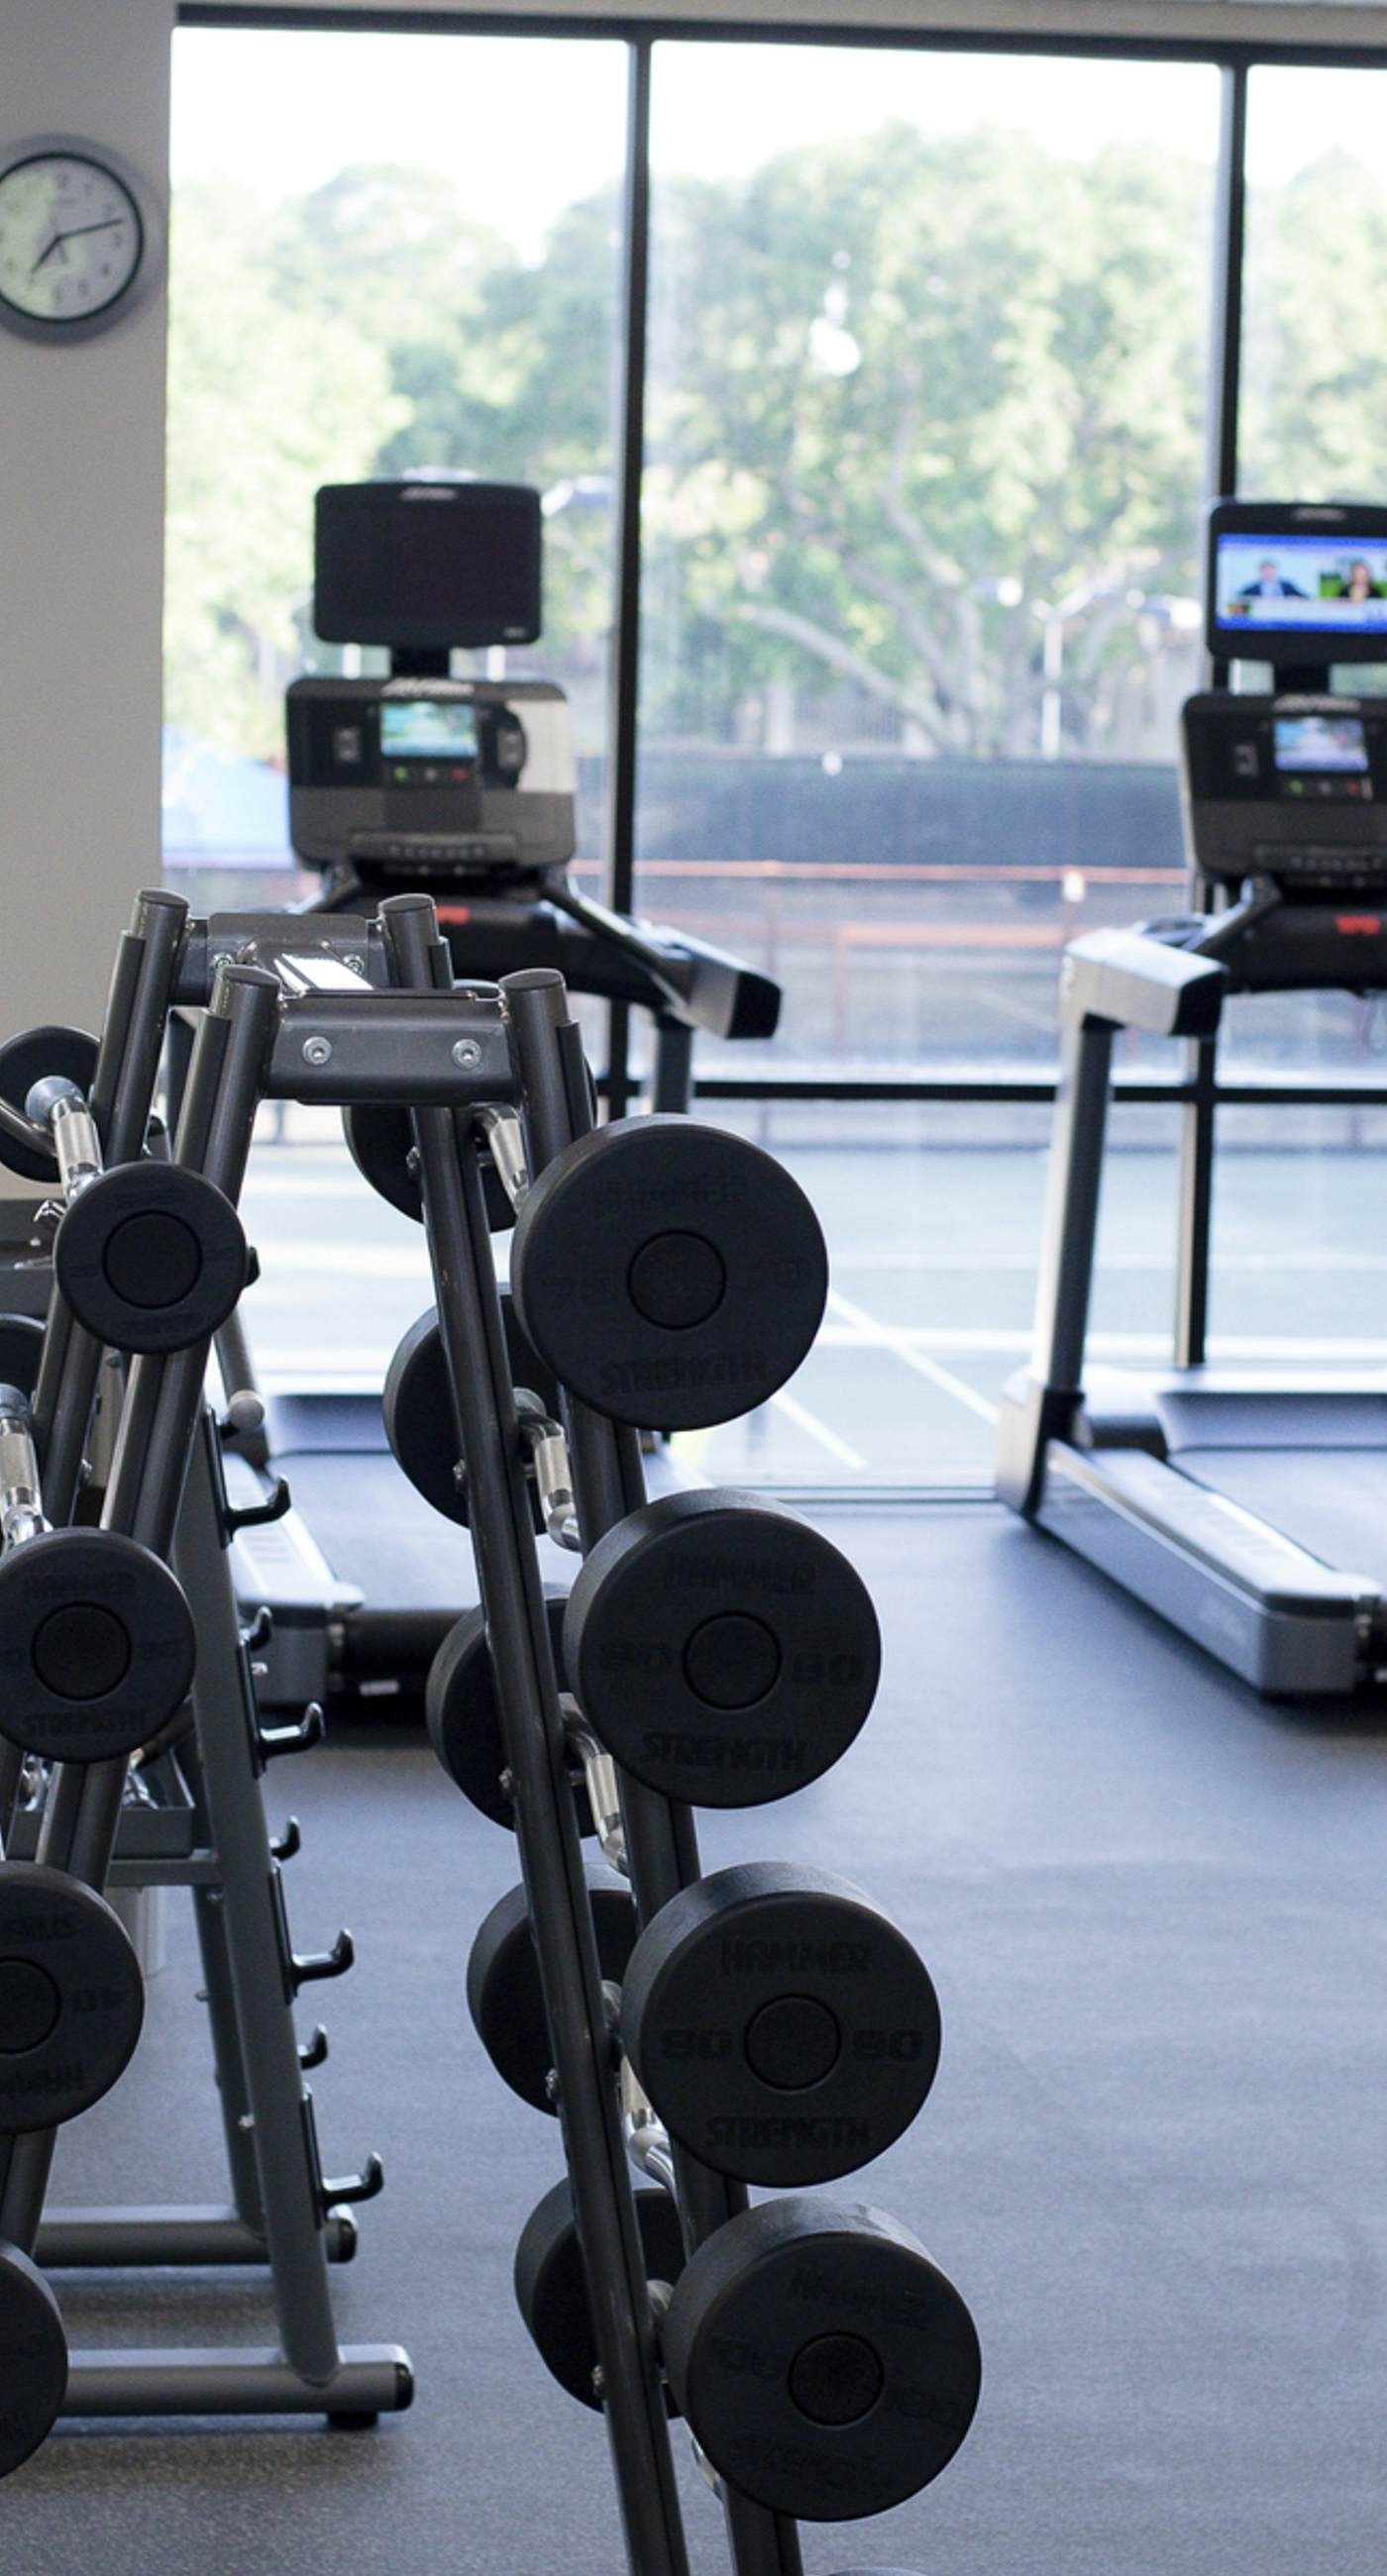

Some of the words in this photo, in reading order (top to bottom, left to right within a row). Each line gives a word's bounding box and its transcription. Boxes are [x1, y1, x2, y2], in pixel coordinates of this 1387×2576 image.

[642, 1732, 810, 1773] STRENGTH
[720, 1938, 872, 1977] HAMMER
[659, 2028, 733, 2061] 80
[851, 2029, 924, 2063] 80
[703, 2114, 870, 2149] STRENGTH
